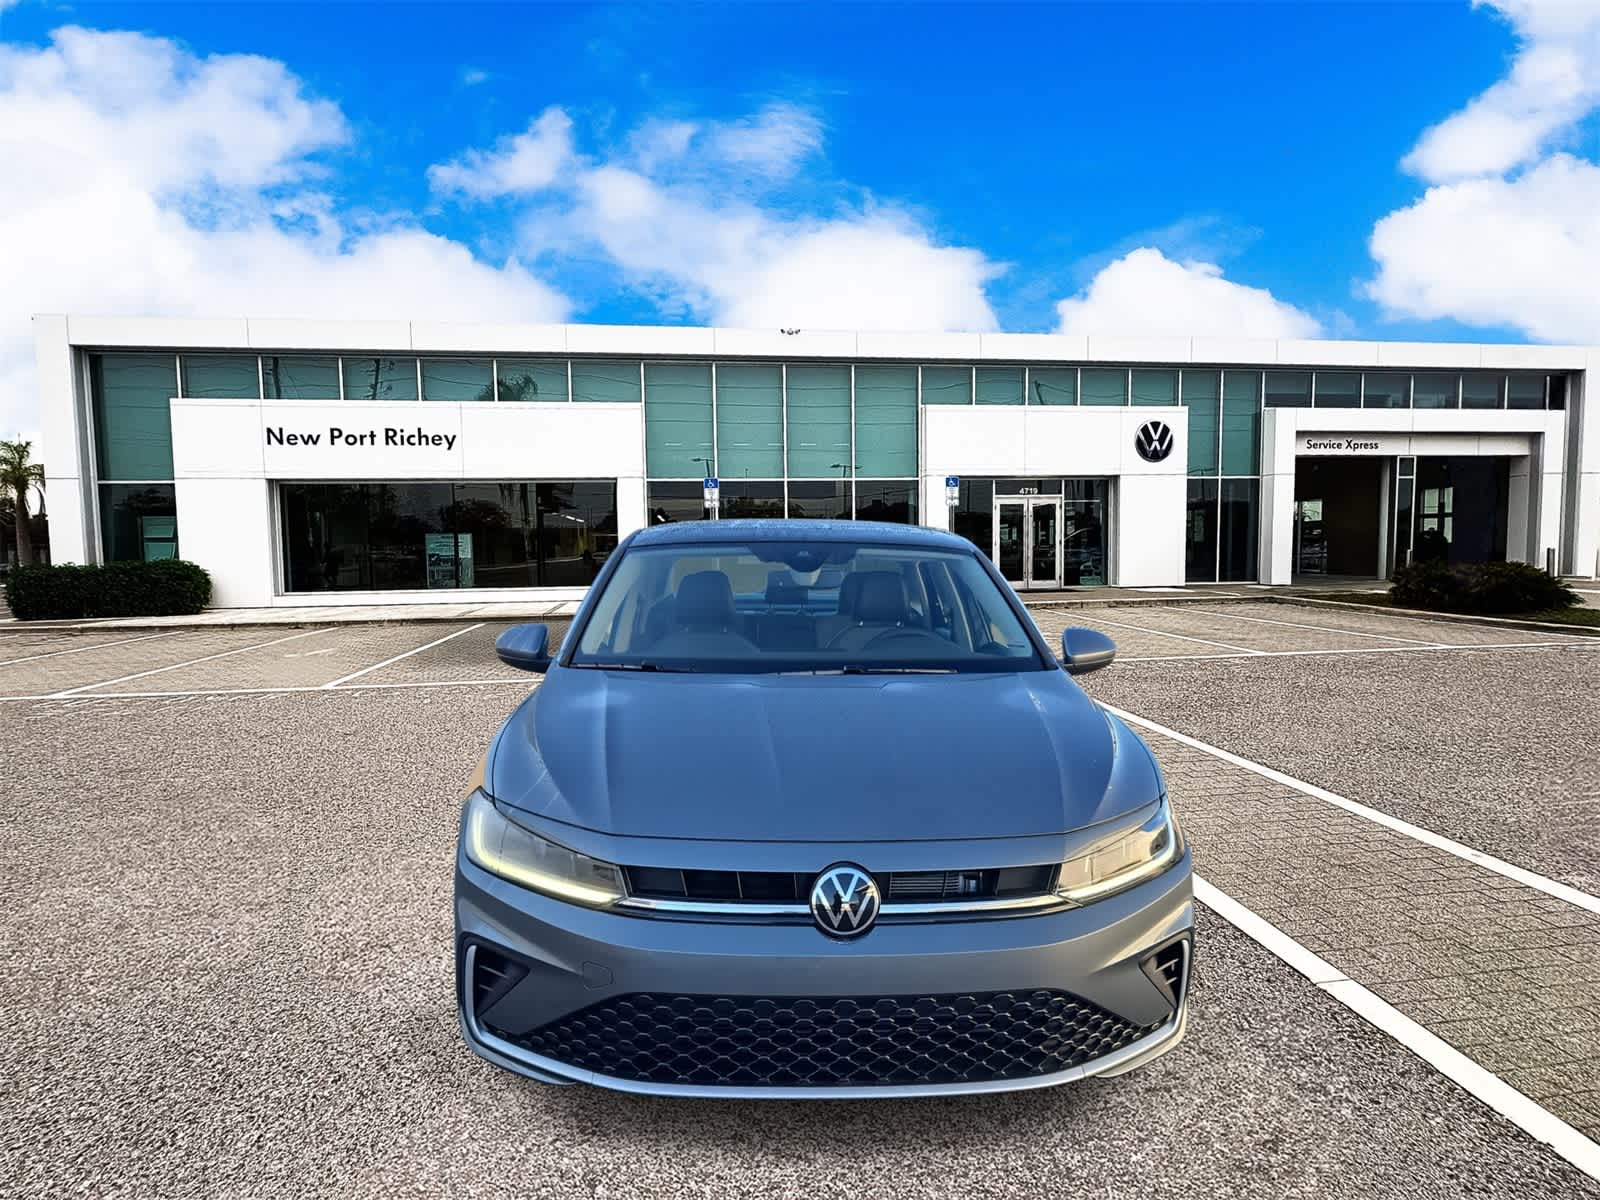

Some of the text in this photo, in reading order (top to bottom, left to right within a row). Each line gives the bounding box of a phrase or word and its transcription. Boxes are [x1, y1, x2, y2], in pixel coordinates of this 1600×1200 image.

[266, 427, 457, 451] New Port Richey
[1306, 439, 1379, 452] Service Xpress
[1019, 487, 1038, 495] 4719
